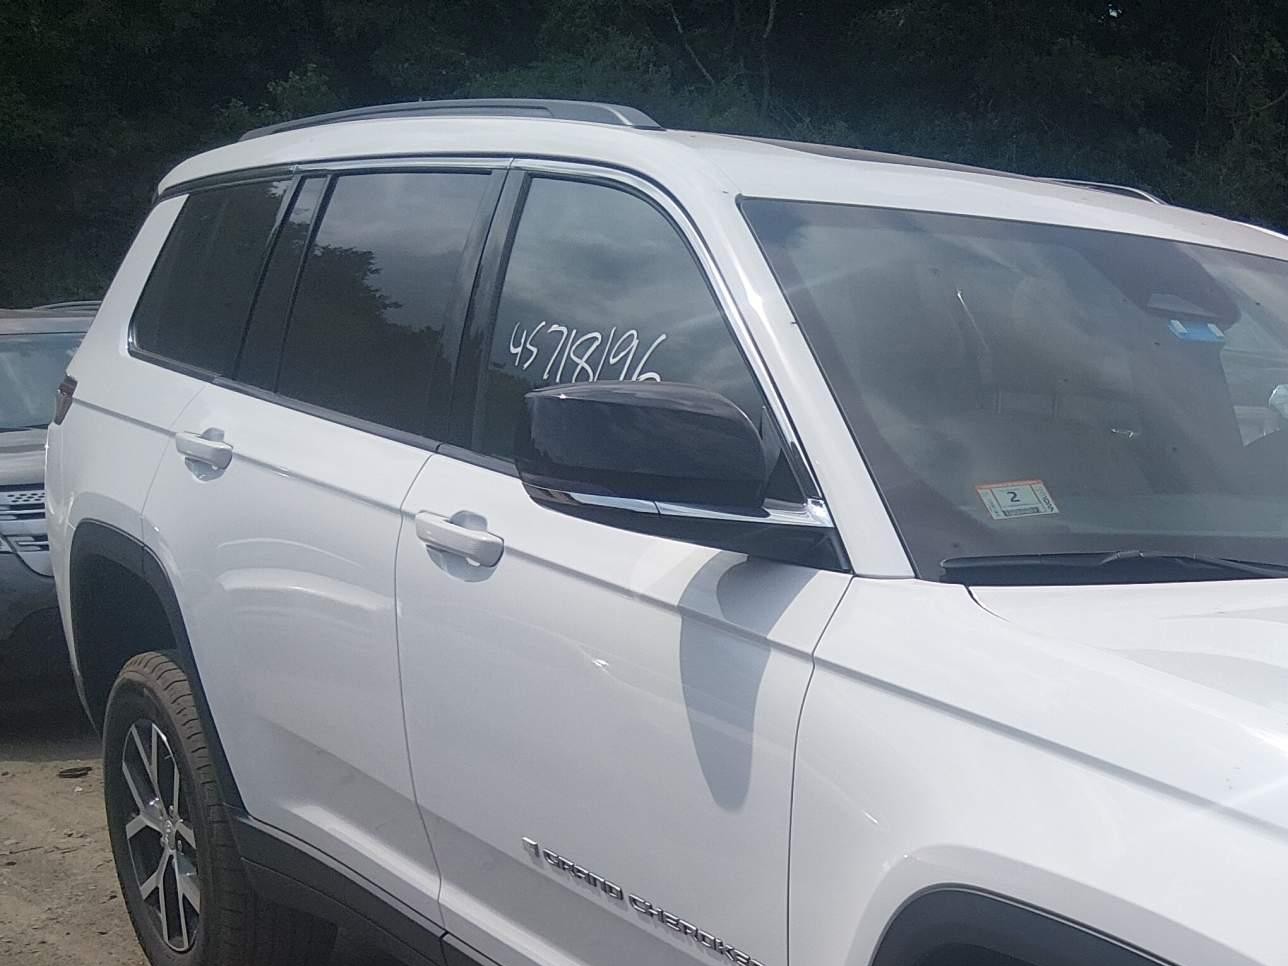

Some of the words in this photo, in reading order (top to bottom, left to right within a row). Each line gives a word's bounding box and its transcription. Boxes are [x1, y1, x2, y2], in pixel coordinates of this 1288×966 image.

[509, 321, 667, 383] 45718196
[1007, 491, 1020, 502] 2
[543, 848, 624, 901] GRAND
